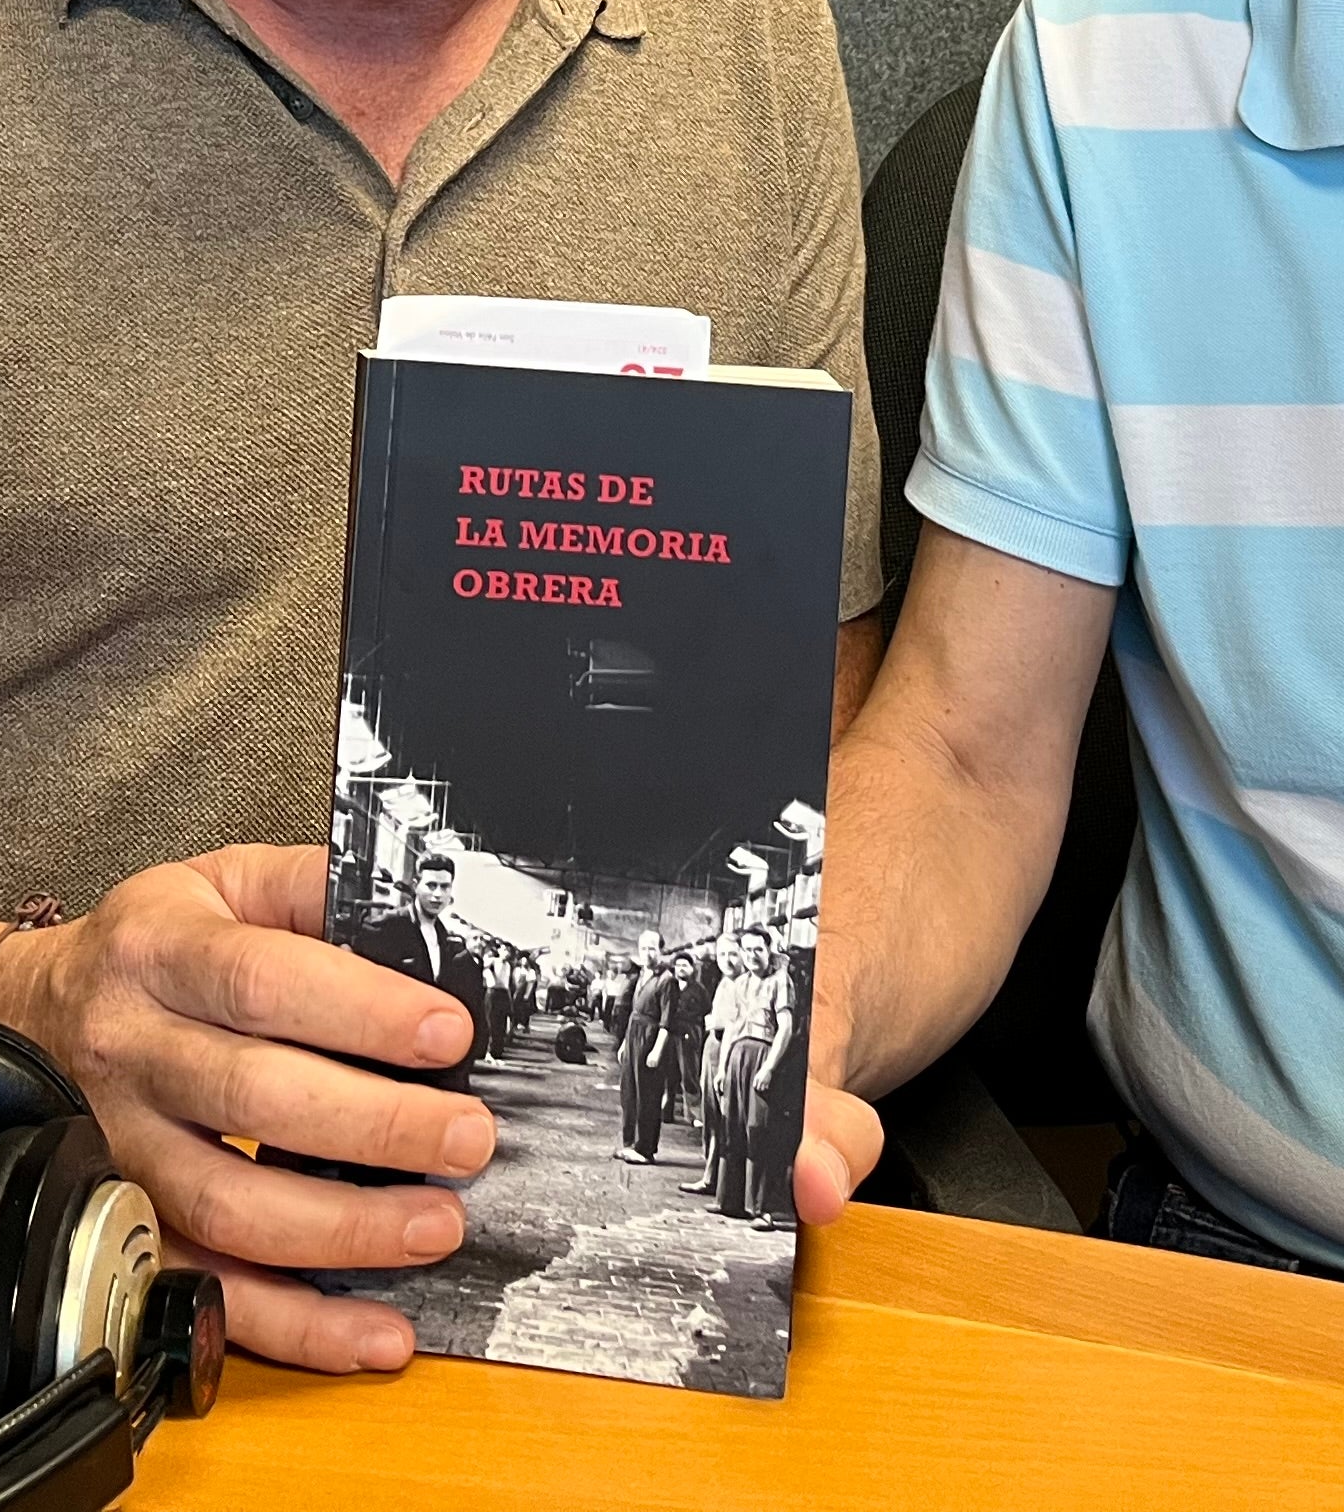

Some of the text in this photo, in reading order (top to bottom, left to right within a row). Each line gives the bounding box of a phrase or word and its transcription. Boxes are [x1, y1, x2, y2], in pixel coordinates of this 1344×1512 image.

[459, 465, 654, 506] RUTAS DE
[456, 517, 731, 564] LA MEMORIA
[453, 569, 623, 608] OBRERA
